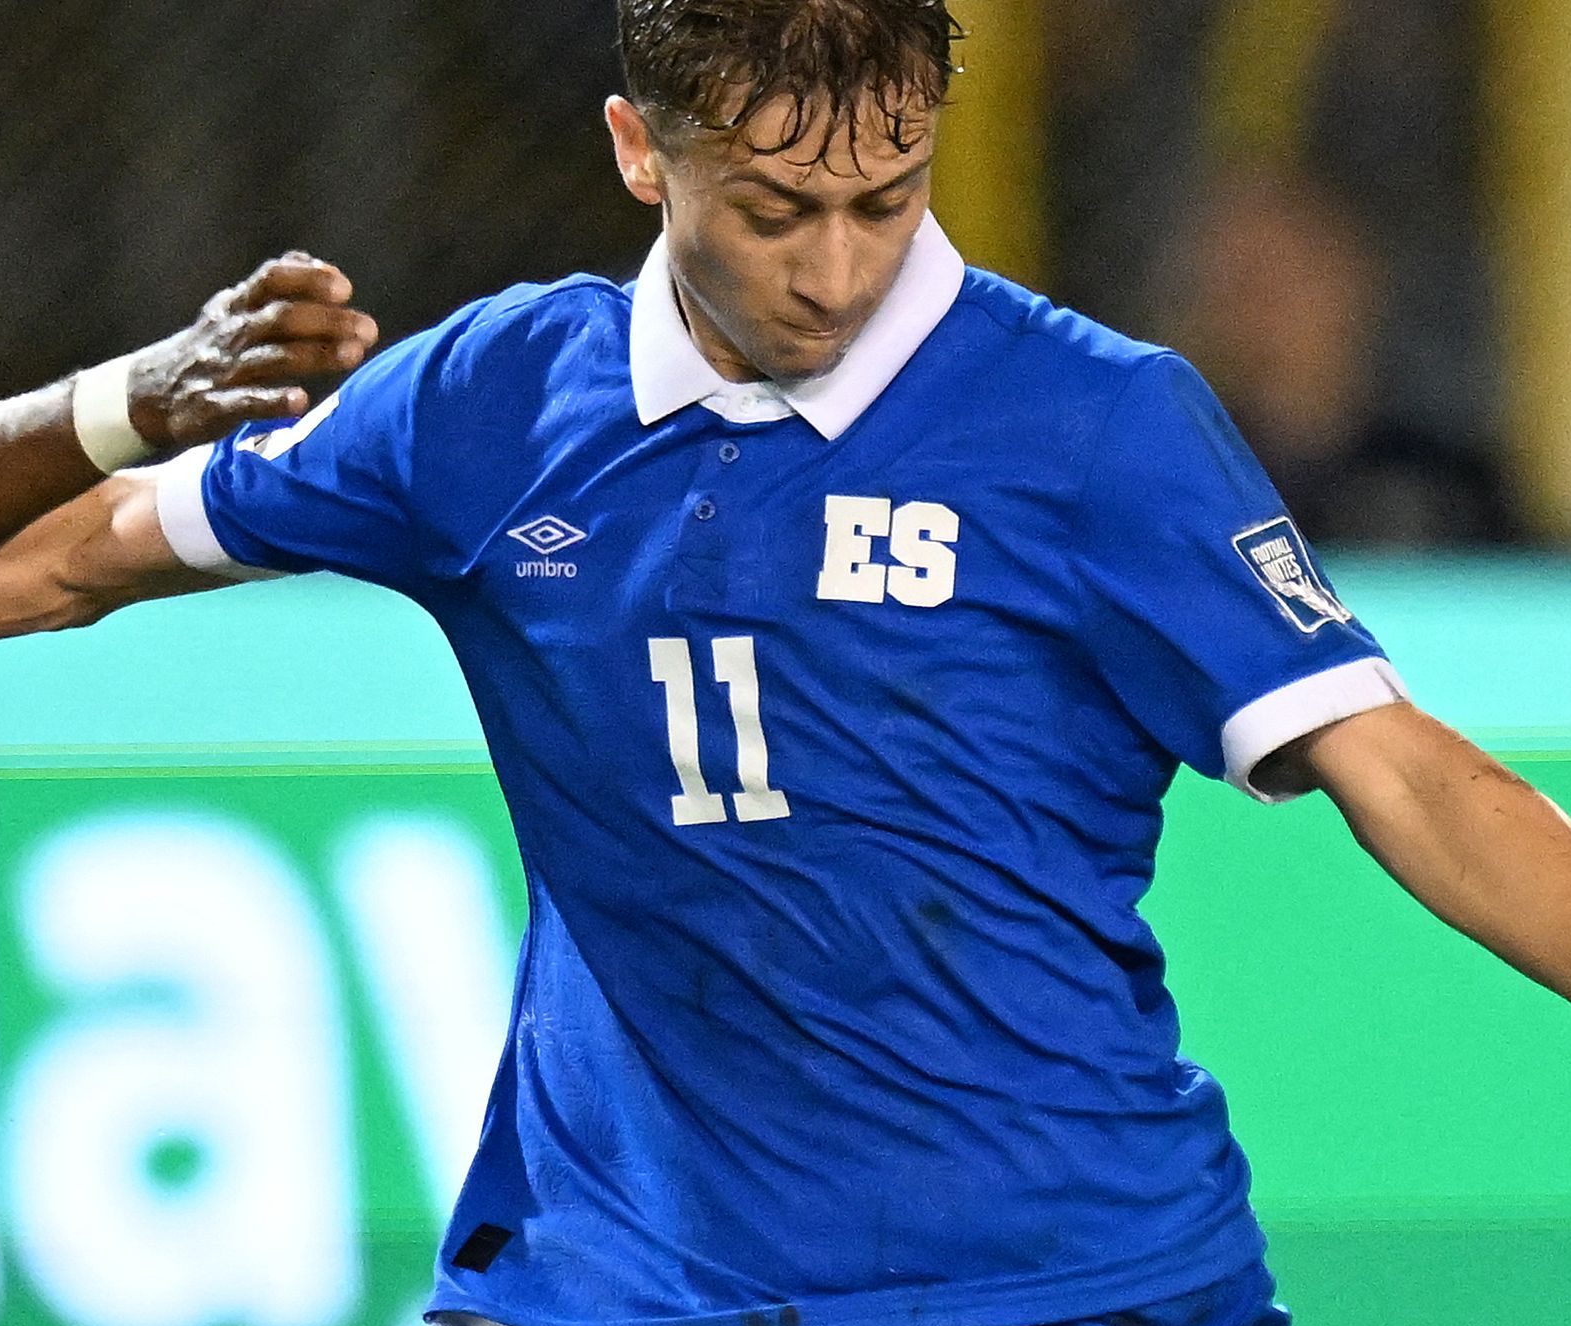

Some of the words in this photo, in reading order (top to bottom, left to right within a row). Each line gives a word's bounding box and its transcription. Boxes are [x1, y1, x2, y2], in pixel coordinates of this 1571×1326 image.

[515, 556, 578, 579] umbro
[816, 494, 960, 608] ES
[648, 635, 791, 826] 11
